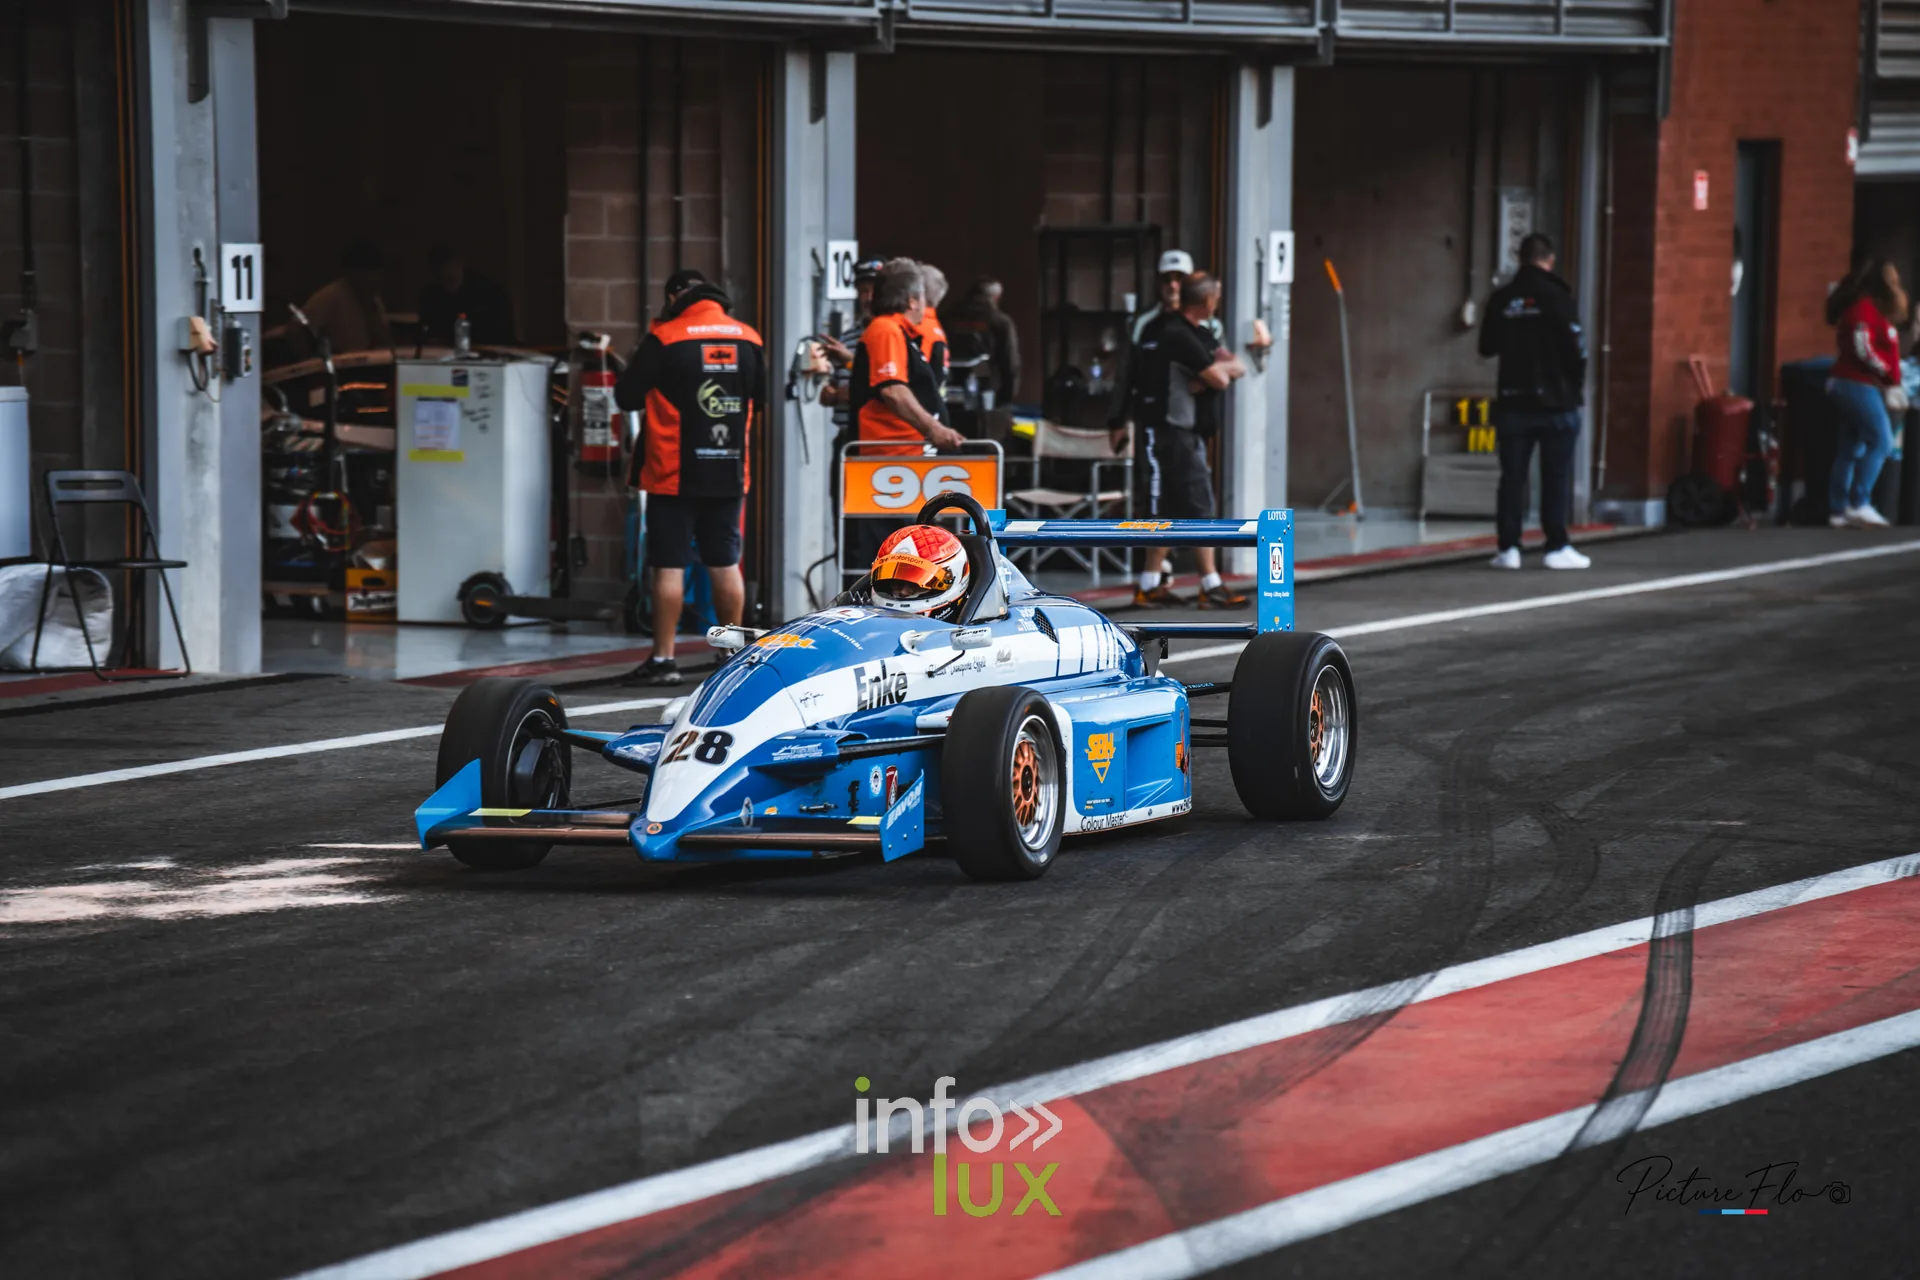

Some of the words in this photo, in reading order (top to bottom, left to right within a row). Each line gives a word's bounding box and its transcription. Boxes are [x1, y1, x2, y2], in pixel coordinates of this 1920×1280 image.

[833, 250, 852, 288] 10
[1278, 241, 1286, 276] 9
[231, 254, 254, 302] 11
[1468, 426, 1497, 452] IN
[871, 464, 973, 510] 96
[1267, 510, 1287, 521] LOTUS
[853, 659, 909, 713] Enke
[658, 728, 737, 768] 28
[1080, 816, 1105, 832] Colour
[1105, 813, 1126, 829] Master
